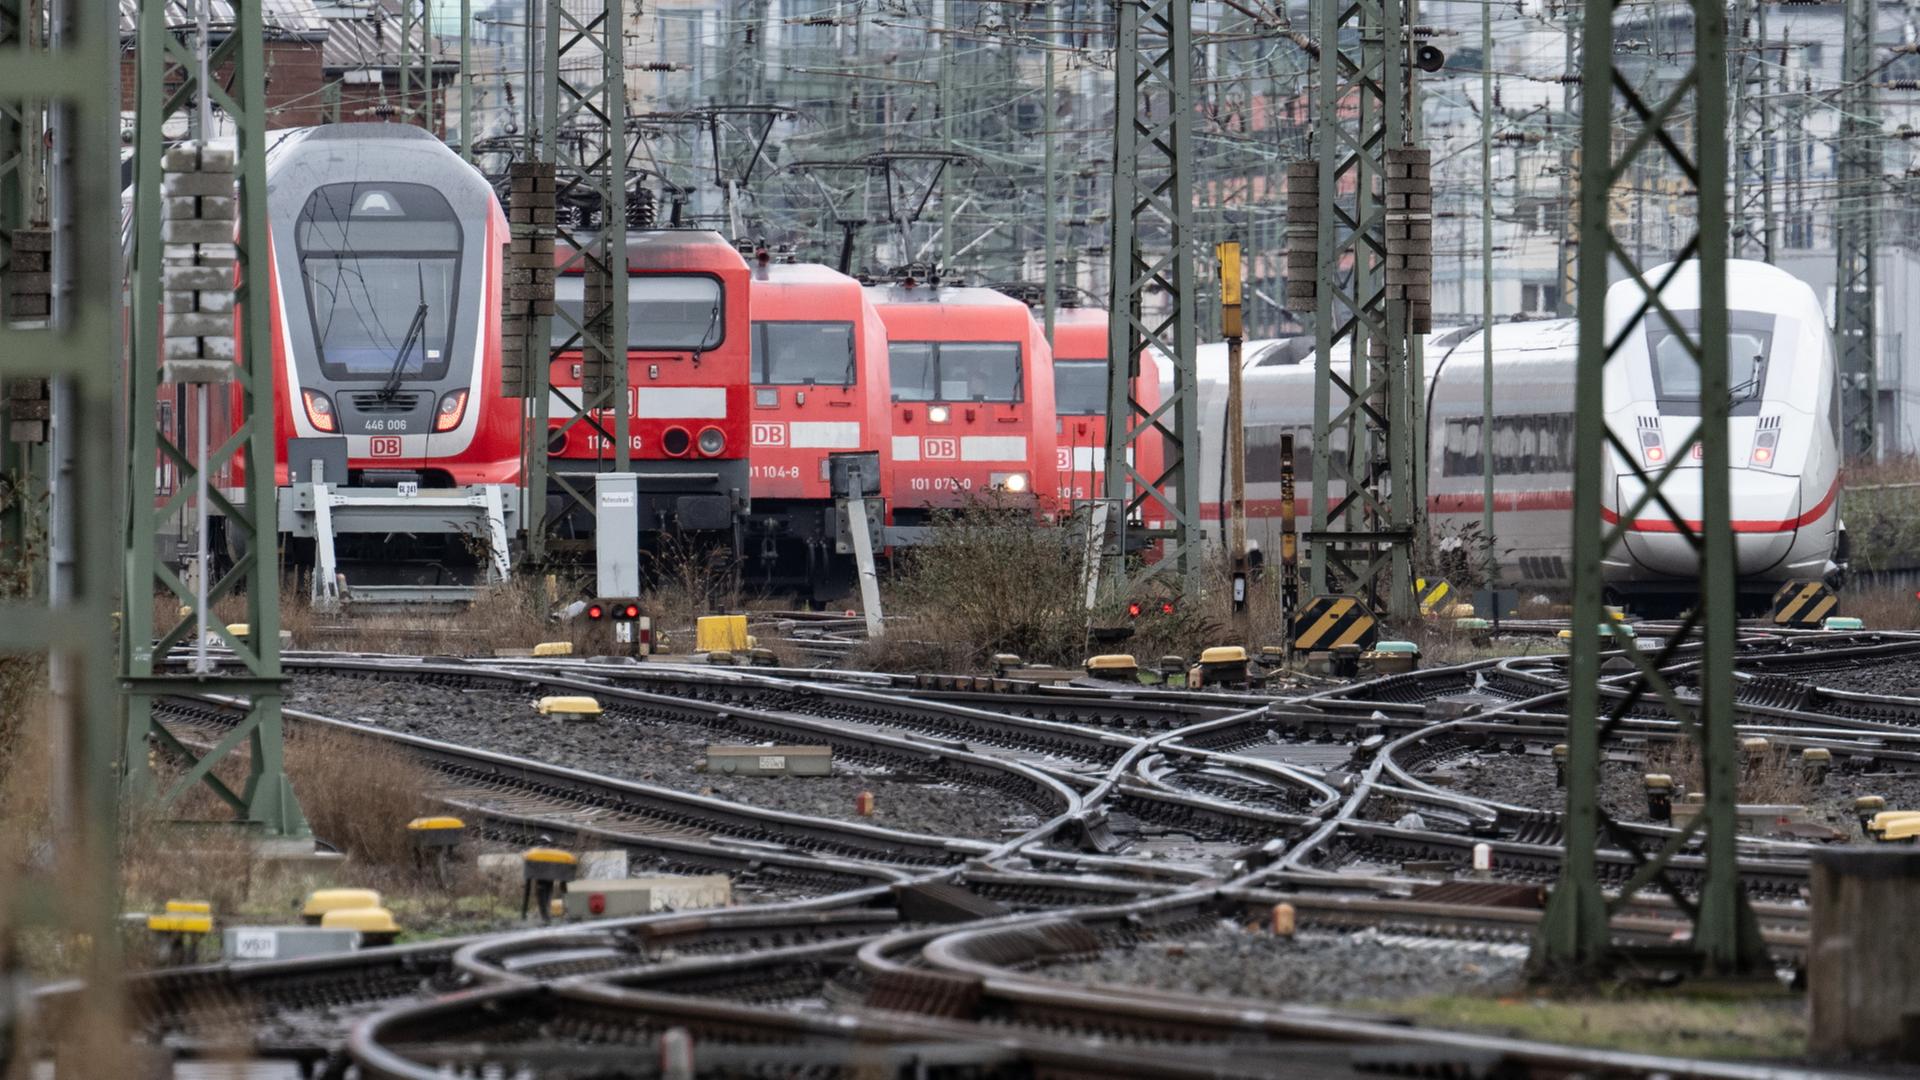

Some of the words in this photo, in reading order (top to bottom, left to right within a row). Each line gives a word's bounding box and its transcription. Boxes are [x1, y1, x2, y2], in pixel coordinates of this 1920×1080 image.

[365, 420, 384, 430] 446
[388, 420, 407, 430] 006
[754, 425, 783, 443] DB
[373, 439, 398, 455] DB
[588, 436, 610, 449] 114
[926, 440, 955, 457] DB
[762, 465, 800, 478] 104-8
[911, 478, 930, 490] 101
